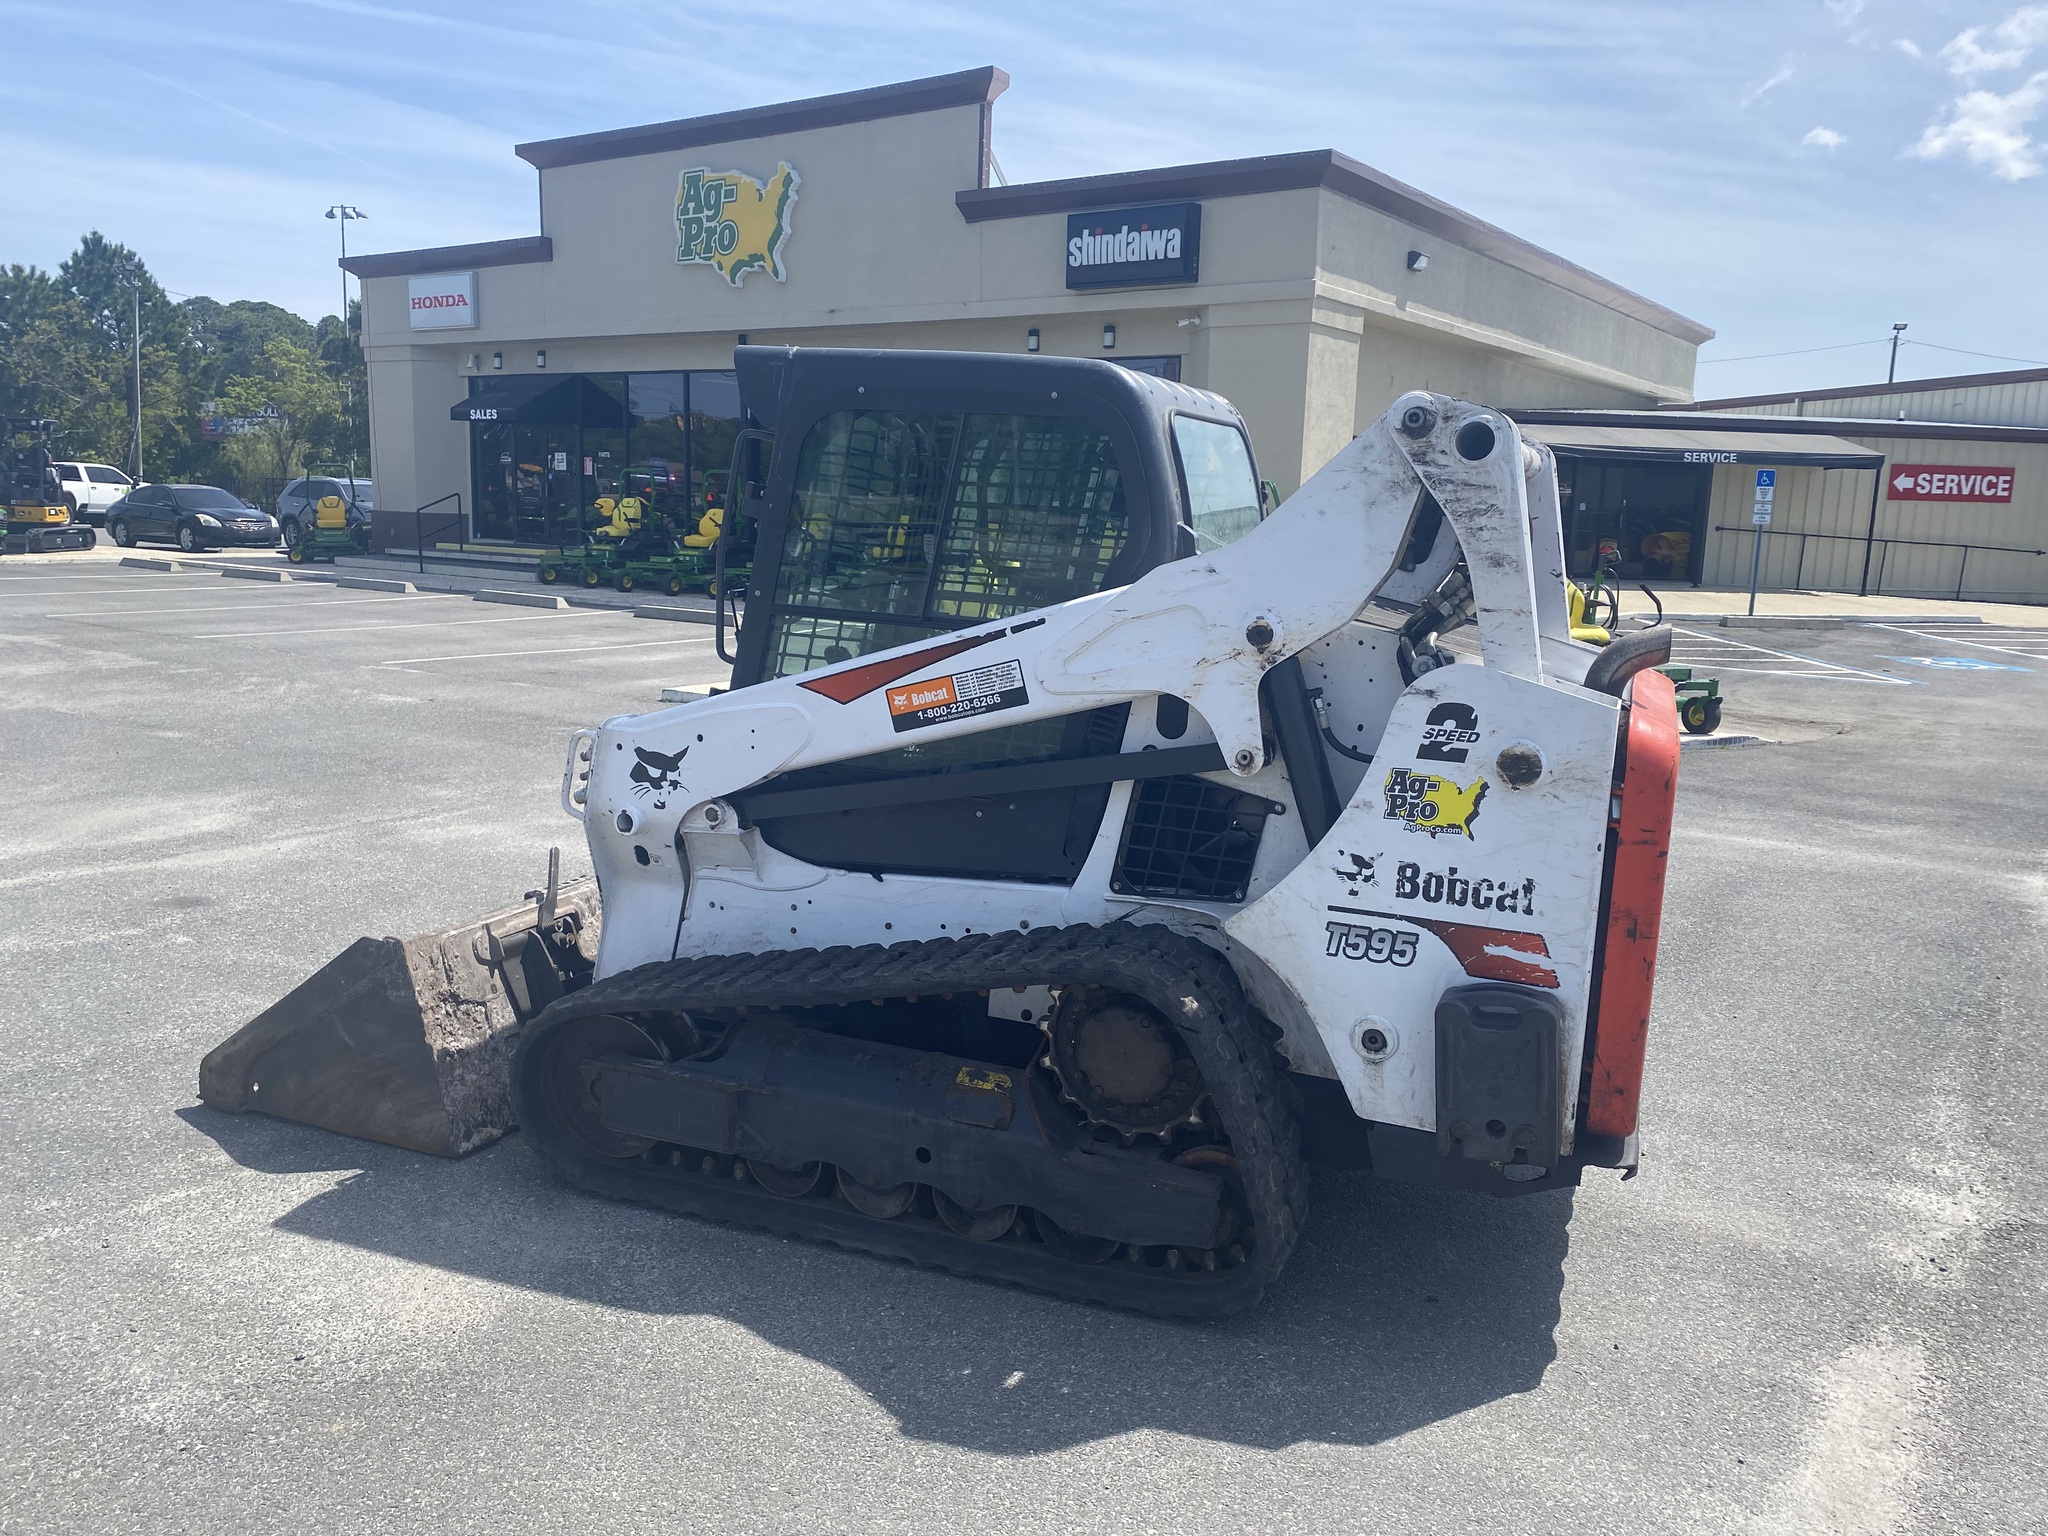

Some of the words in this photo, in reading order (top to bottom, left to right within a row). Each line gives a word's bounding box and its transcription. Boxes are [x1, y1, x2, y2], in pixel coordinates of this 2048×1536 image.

[677, 169, 738, 224] Ag-
[677, 216, 739, 262] Pro
[1068, 223, 1182, 268] shindaiwa
[411, 293, 469, 310] HONDA
[469, 408, 498, 420] SALES
[1683, 452, 1738, 463] SERVICE
[1916, 473, 2012, 497] SERVICE
[911, 687, 949, 706] Bobcat
[917, 693, 1001, 720] 1-800-220-6266
[1416, 702, 1478, 763] 2
[1422, 728, 1481, 743] SPEED
[1384, 768, 1440, 800] Ag-
[1383, 794, 1439, 821] Pro
[1403, 822, 1463, 835] AgProCo.com
[1395, 860, 1536, 916] Bobcat
[1326, 921, 1419, 967] T595
